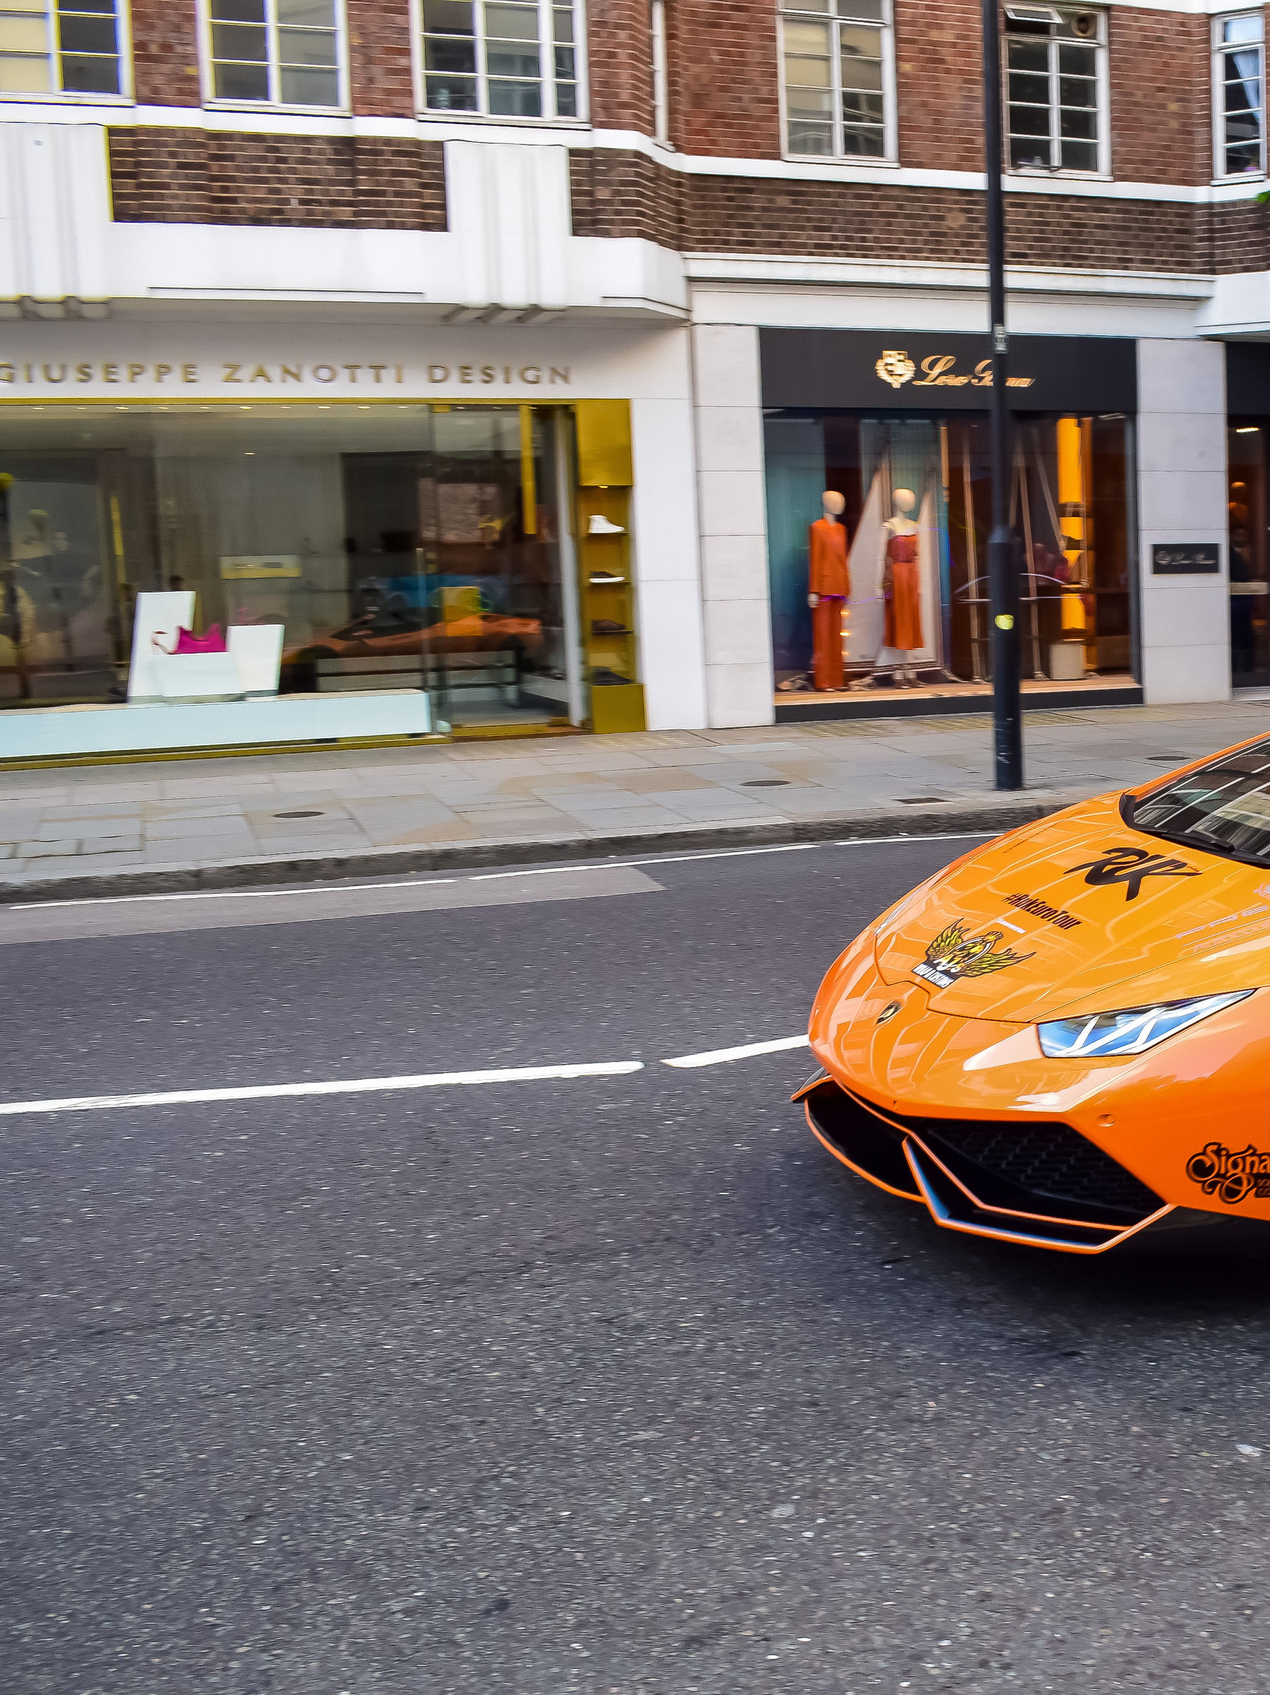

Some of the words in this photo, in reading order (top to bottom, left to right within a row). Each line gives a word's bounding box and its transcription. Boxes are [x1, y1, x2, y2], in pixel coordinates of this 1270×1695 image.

[0, 362, 199, 384] GIUSEPPE
[221, 363, 405, 384] ZANOTTI
[427, 364, 572, 385] DESIGN
